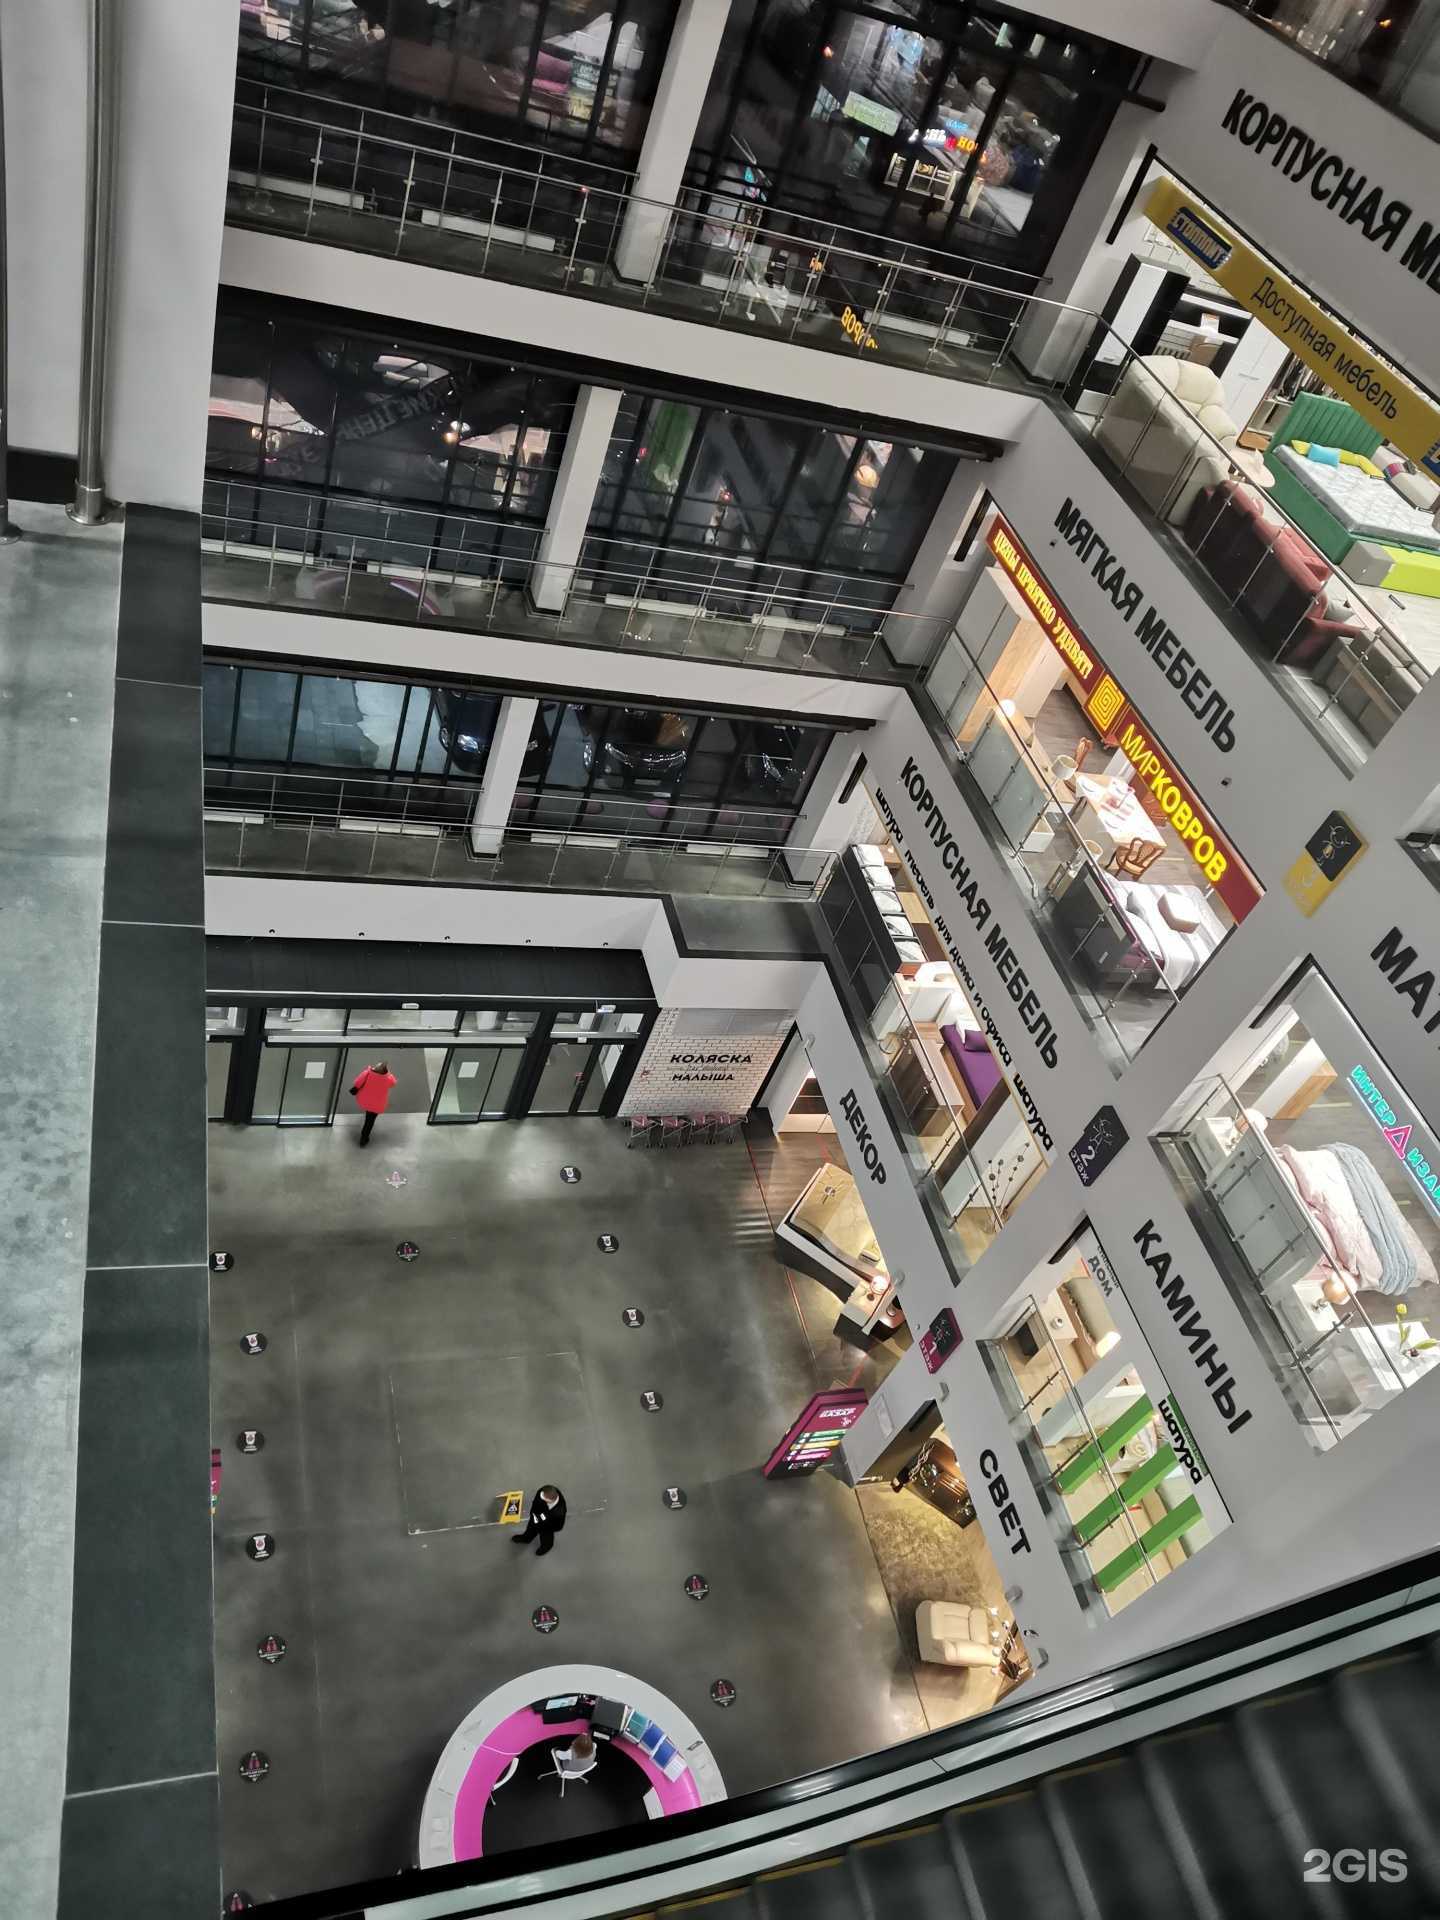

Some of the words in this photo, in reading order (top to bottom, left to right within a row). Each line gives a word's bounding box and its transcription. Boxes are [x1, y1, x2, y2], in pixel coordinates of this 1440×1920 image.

[1221, 88, 1412, 252] КОРПУСНАЯ
[1251, 277, 1336, 362] Доступная
[1334, 353, 1398, 420] мебель
[993, 528, 1021, 572] ЦЕНЫ
[1015, 562, 1056, 625] ПРИЯТНО
[1054, 497, 1144, 622] МЯГКАЯ
[1134, 606, 1235, 753] МЕБЕЛЬ
[900, 756, 992, 931] КОРПУСНАЯ
[984, 923, 1058, 1069] МЕБЕЛЬ
[875, 788, 904, 844] шатура
[904, 849, 935, 910] мебель
[934, 915, 952, 945] для
[949, 946, 976, 992] дома
[973, 992, 988, 1008] и
[981, 1007, 1013, 1067] офиса
[1013, 1073, 1054, 1152] шатура
[671, 1054, 752, 1064] КОЛЯСКА
[672, 1073, 734, 1081] МАЛЫША
[839, 1088, 886, 1185] ДЕКОР
[1070, 1149, 1089, 1183] этаж
[1080, 1145, 1096, 1167] 2
[1088, 1256, 1112, 1298] ДОМ
[1133, 1218, 1253, 1435] КАМИНЫ
[1158, 1399, 1203, 1485] шатура
[979, 1449, 1031, 1554] СВЕТ
